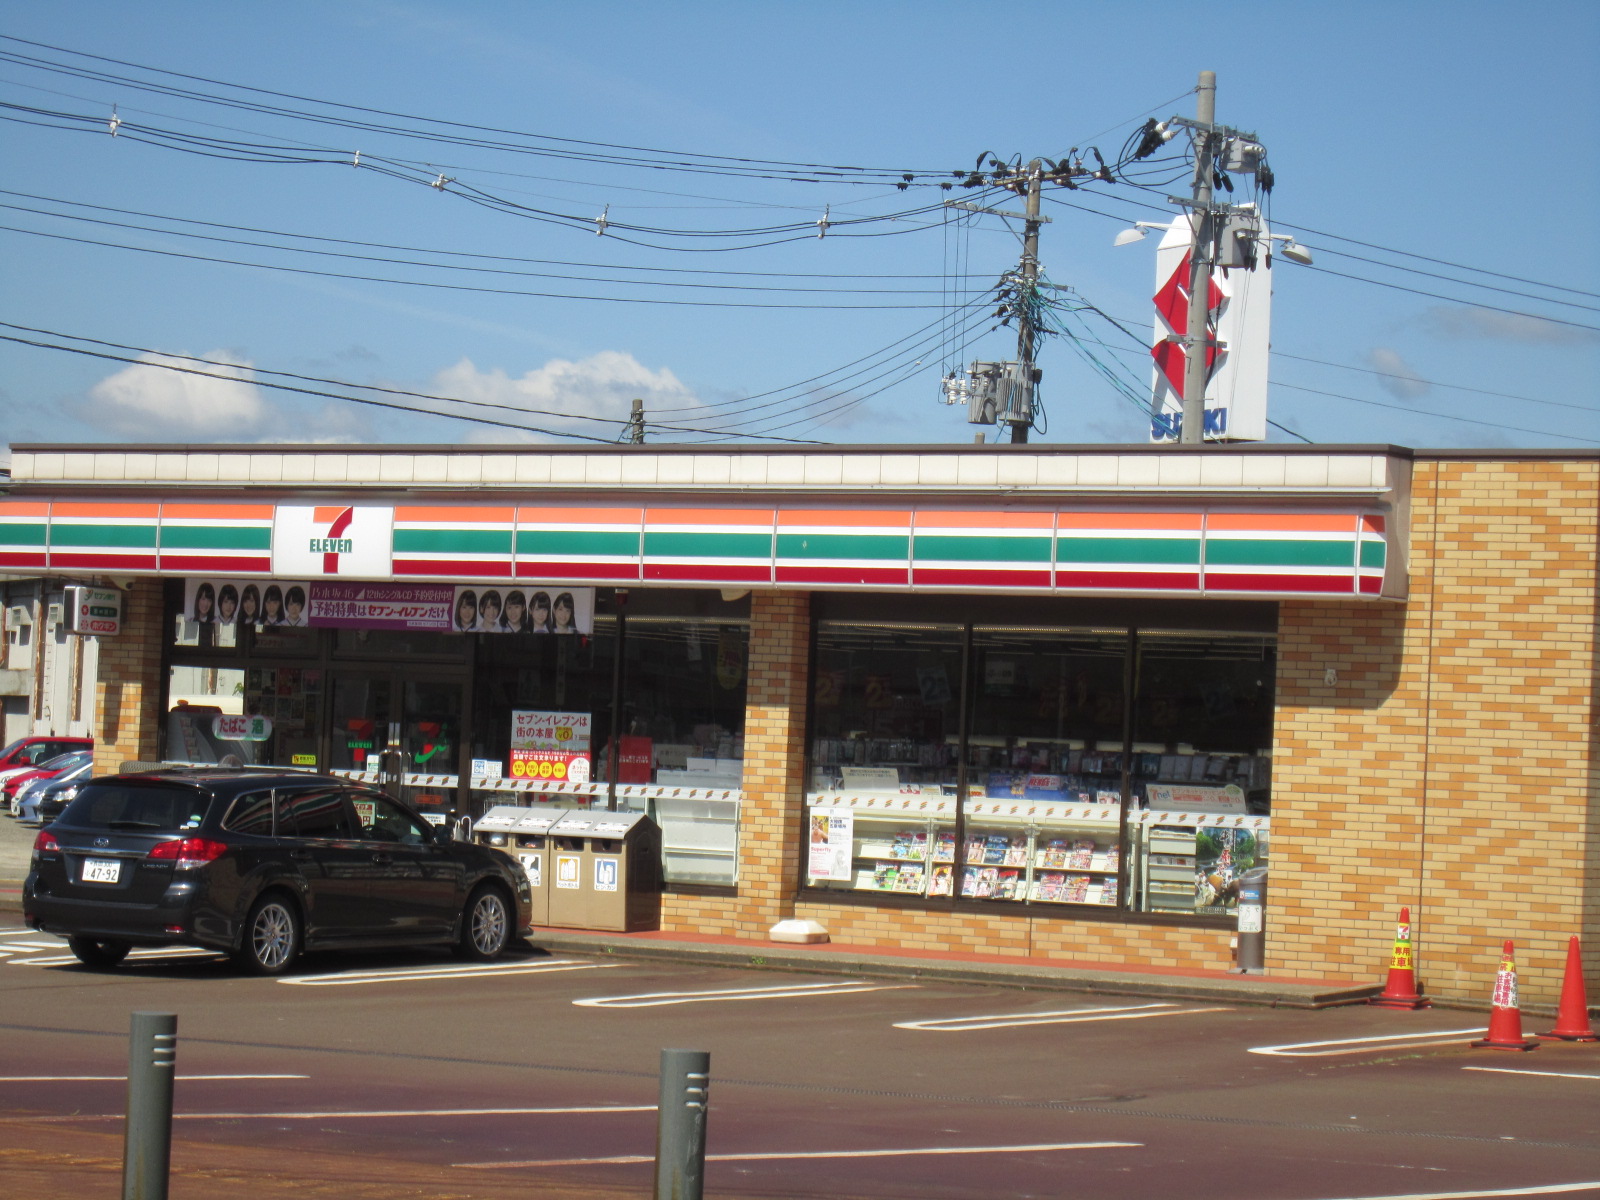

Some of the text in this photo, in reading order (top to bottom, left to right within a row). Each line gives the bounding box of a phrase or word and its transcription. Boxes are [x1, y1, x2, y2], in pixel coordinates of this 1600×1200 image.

[1152, 408, 1228, 438] SUKI
[313, 506, 354, 574] 7
[219, 718, 264, 734] たばこ 酒
[516, 727, 554, 739] 街の本屋
[90, 868, 118, 881] 47-92
